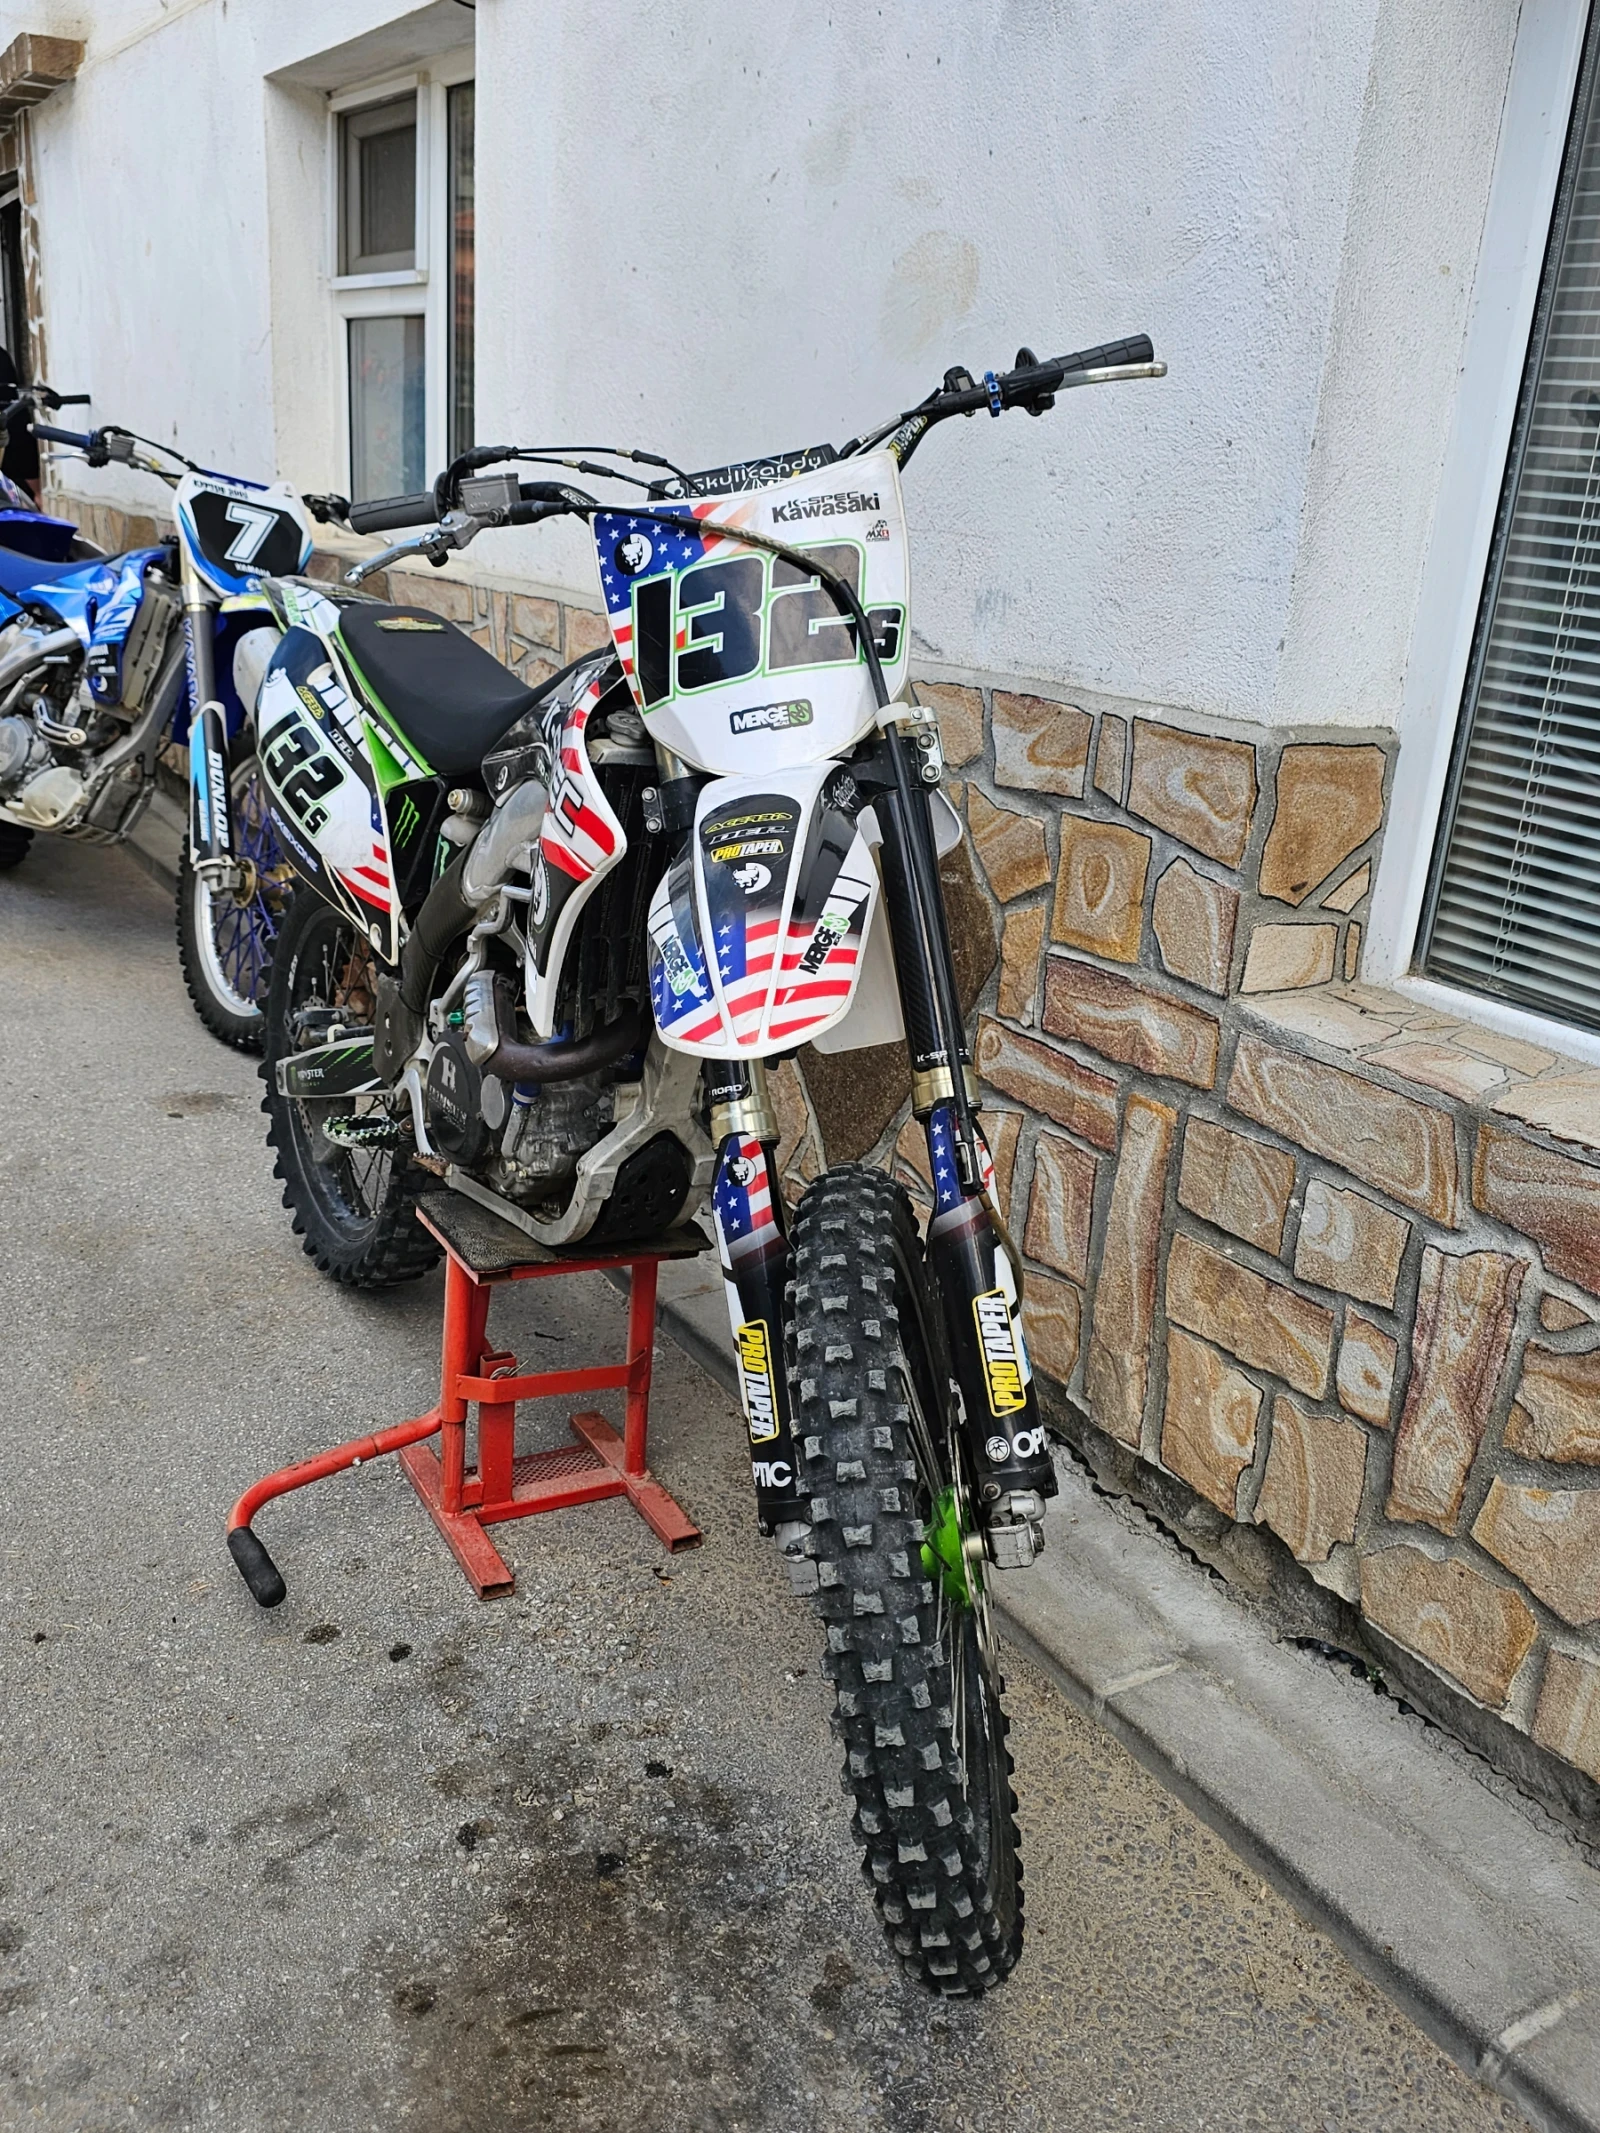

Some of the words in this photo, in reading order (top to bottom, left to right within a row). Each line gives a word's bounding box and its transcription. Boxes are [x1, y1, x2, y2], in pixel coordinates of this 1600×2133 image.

[693, 455, 822, 493] Skullcandy
[772, 493, 881, 523] Kawasaki
[787, 491, 860, 508] K-SPEC
[223, 501, 279, 563] 7
[733, 705, 790, 731] MERGE
[208, 748, 230, 848] DUNLOP
[704, 812, 793, 835] ACERBIS
[660, 934, 691, 979] MERGE
[798, 924, 837, 975] MERGE
